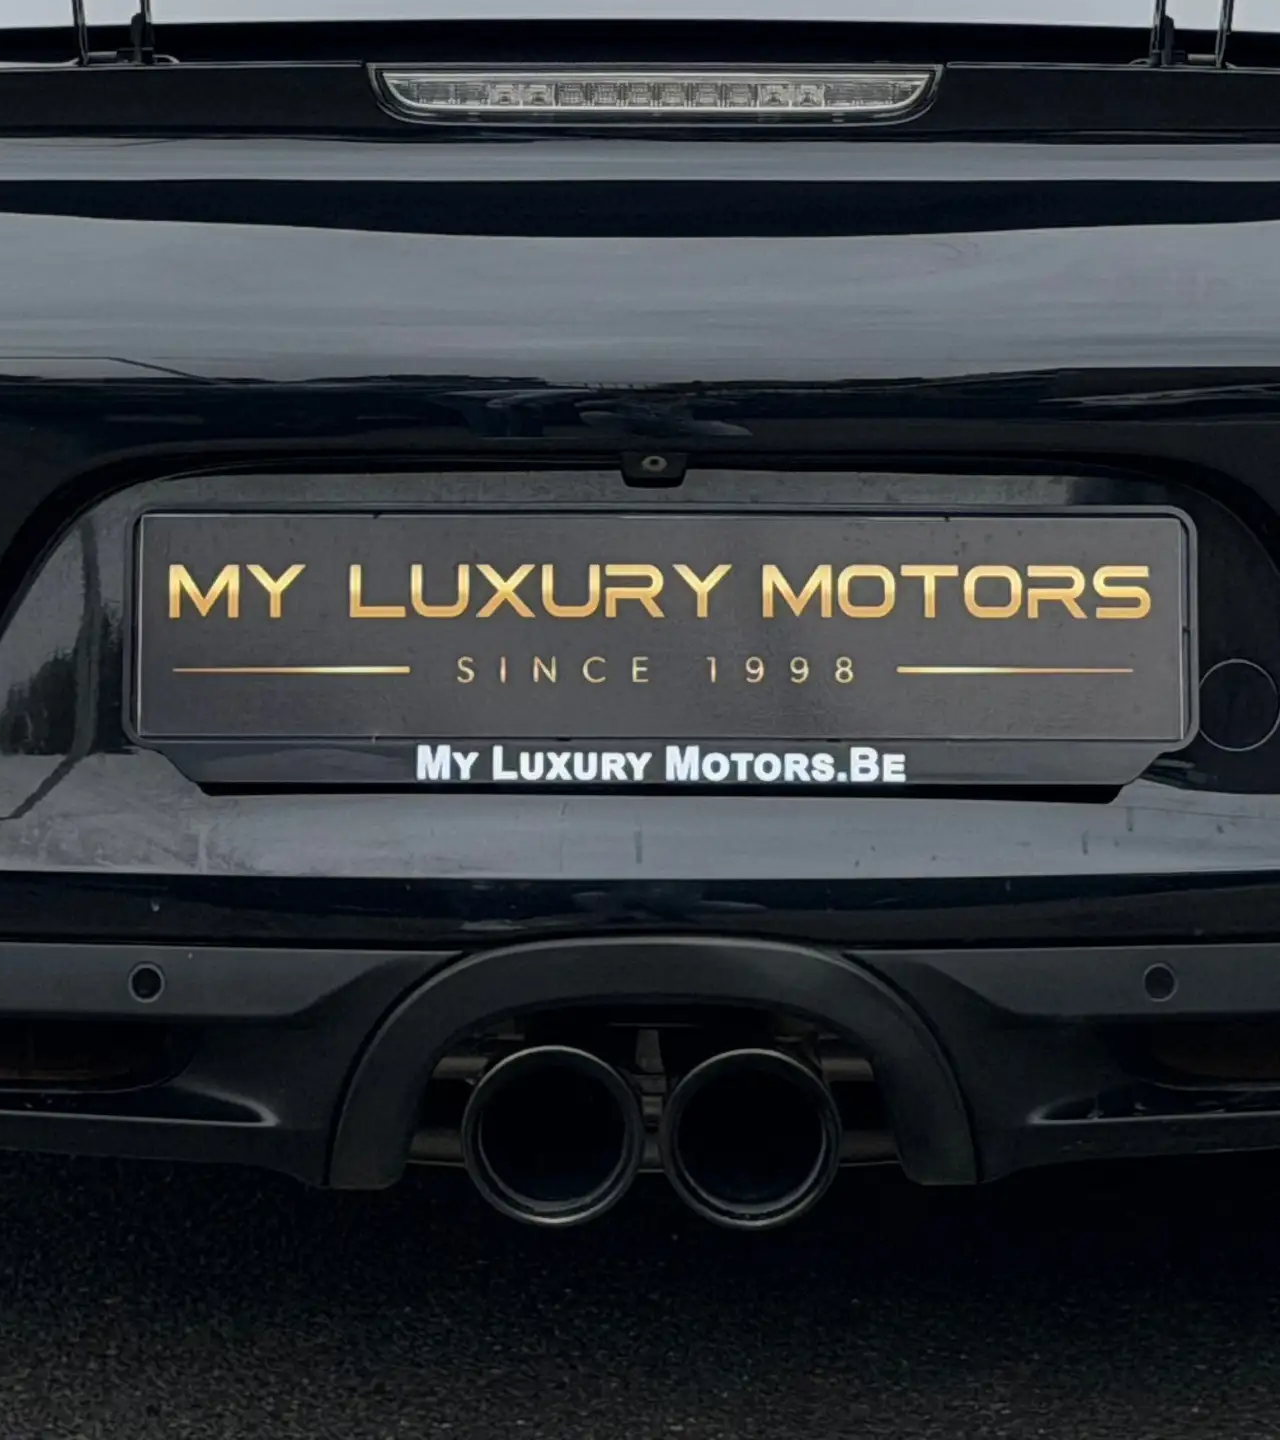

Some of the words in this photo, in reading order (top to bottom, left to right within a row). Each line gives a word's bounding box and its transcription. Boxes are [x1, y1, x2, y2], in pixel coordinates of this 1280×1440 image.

[168, 563, 306, 618] MY
[349, 563, 732, 618] LUXURY
[762, 564, 1152, 619] MOTORS
[456, 655, 650, 683] SINCE
[706, 655, 855, 683] 1998
